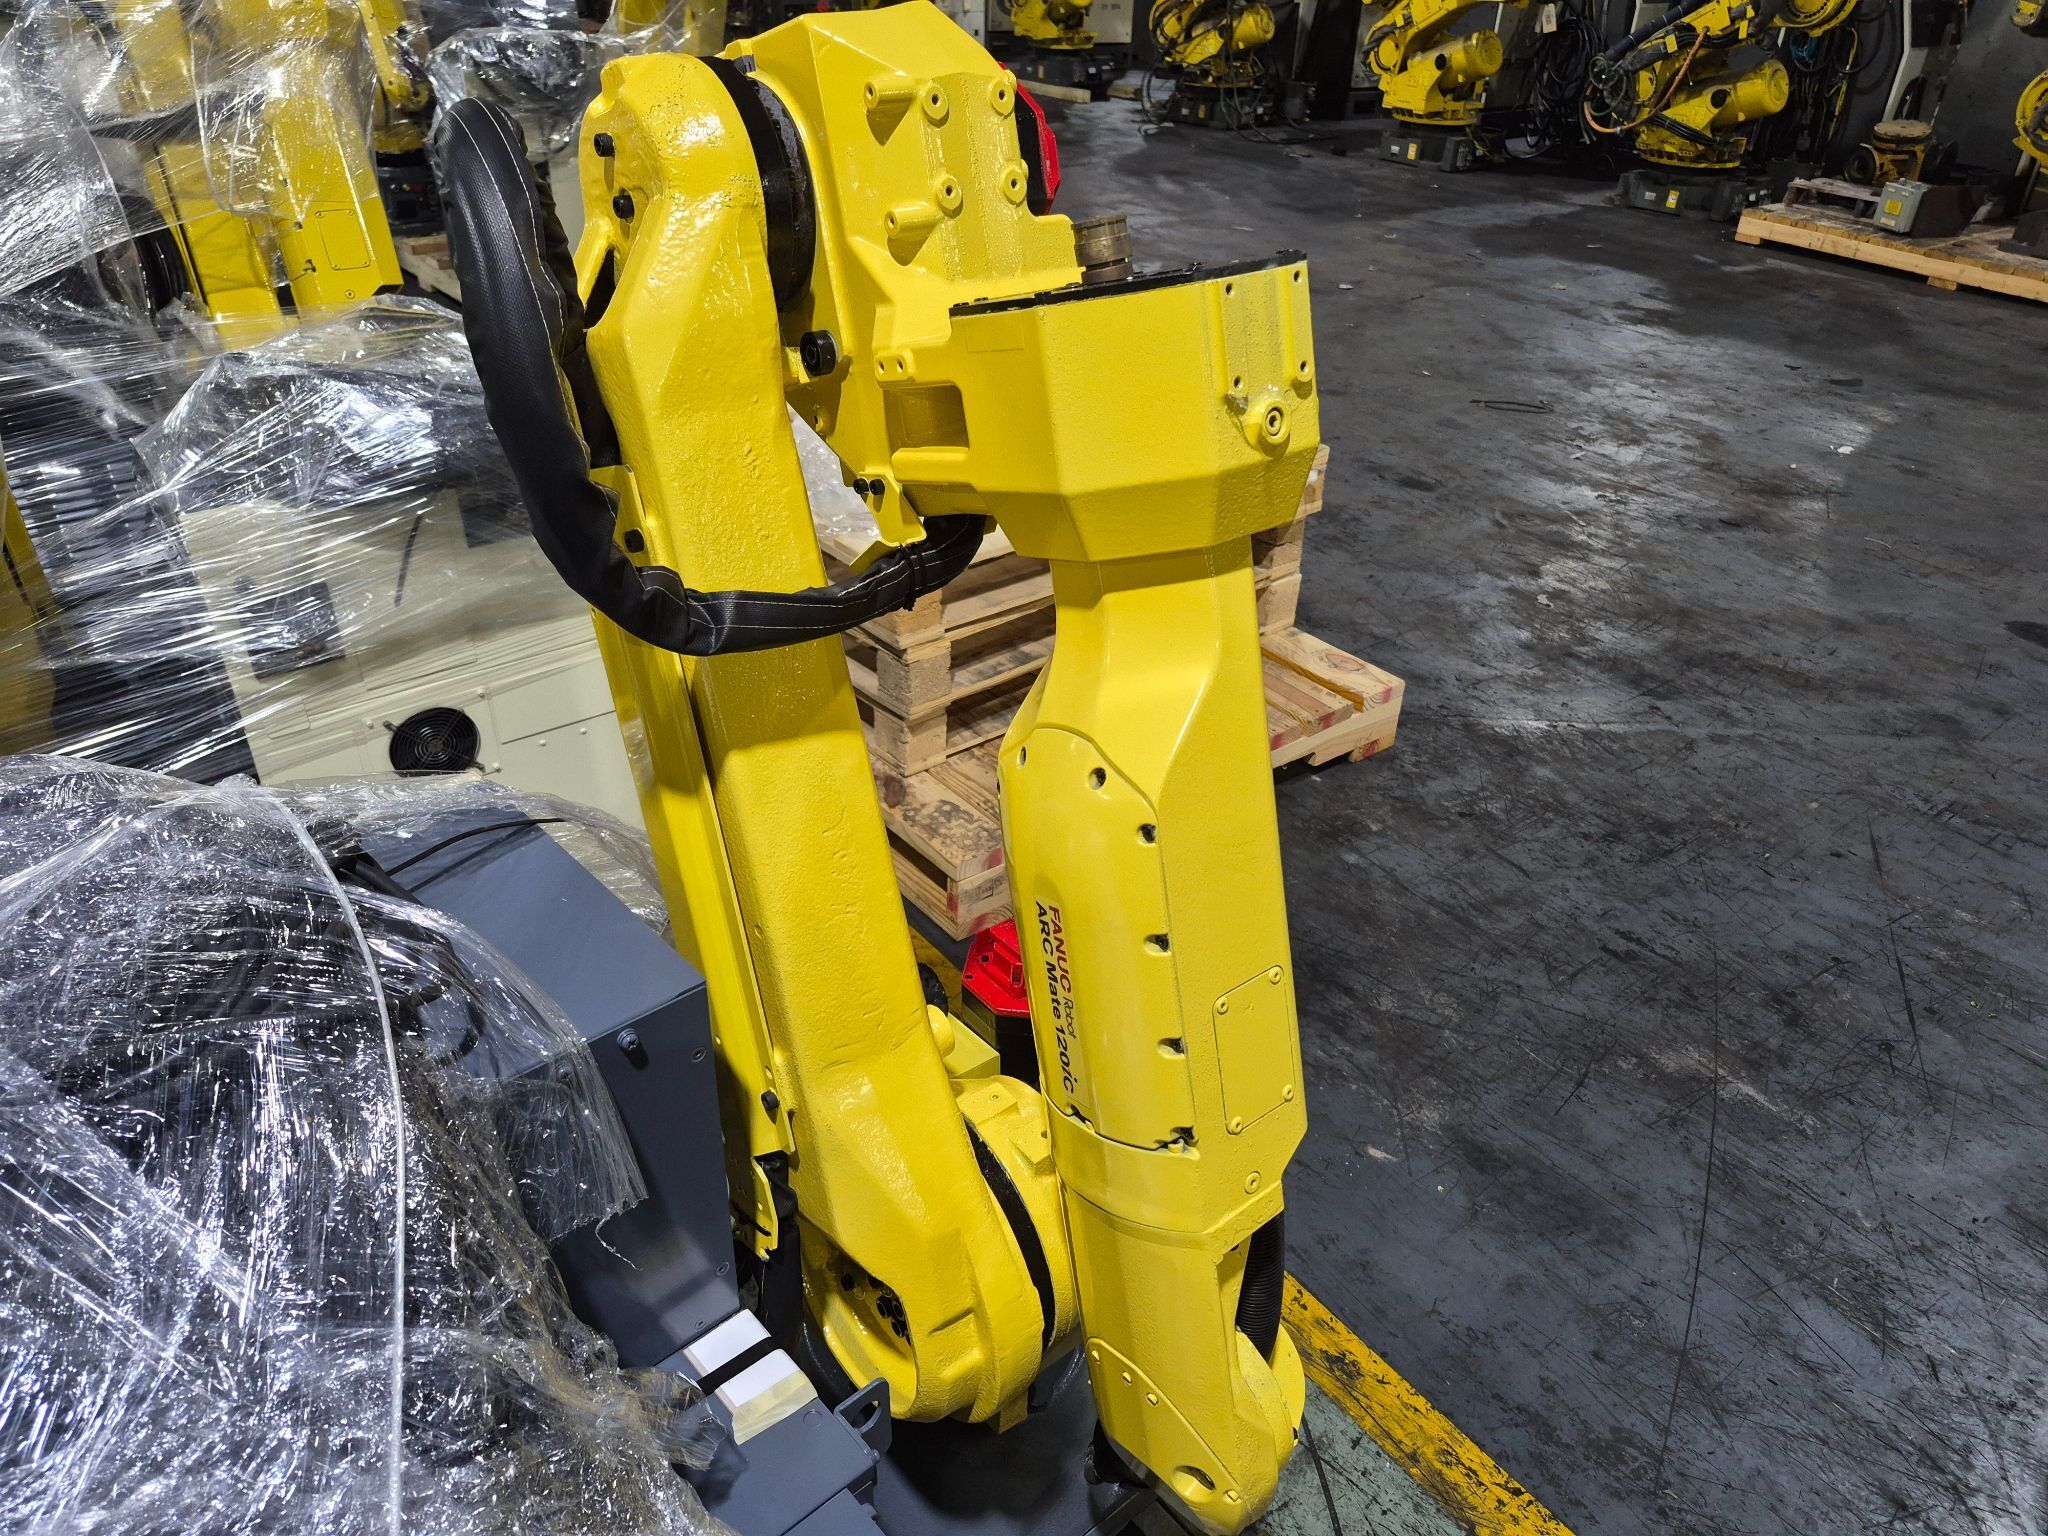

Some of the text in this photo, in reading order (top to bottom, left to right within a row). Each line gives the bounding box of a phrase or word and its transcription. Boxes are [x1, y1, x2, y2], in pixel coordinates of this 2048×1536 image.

[1036, 900, 1078, 1094] ARC Mate 120iC
[1048, 905, 1076, 1039] FANUC Robot
